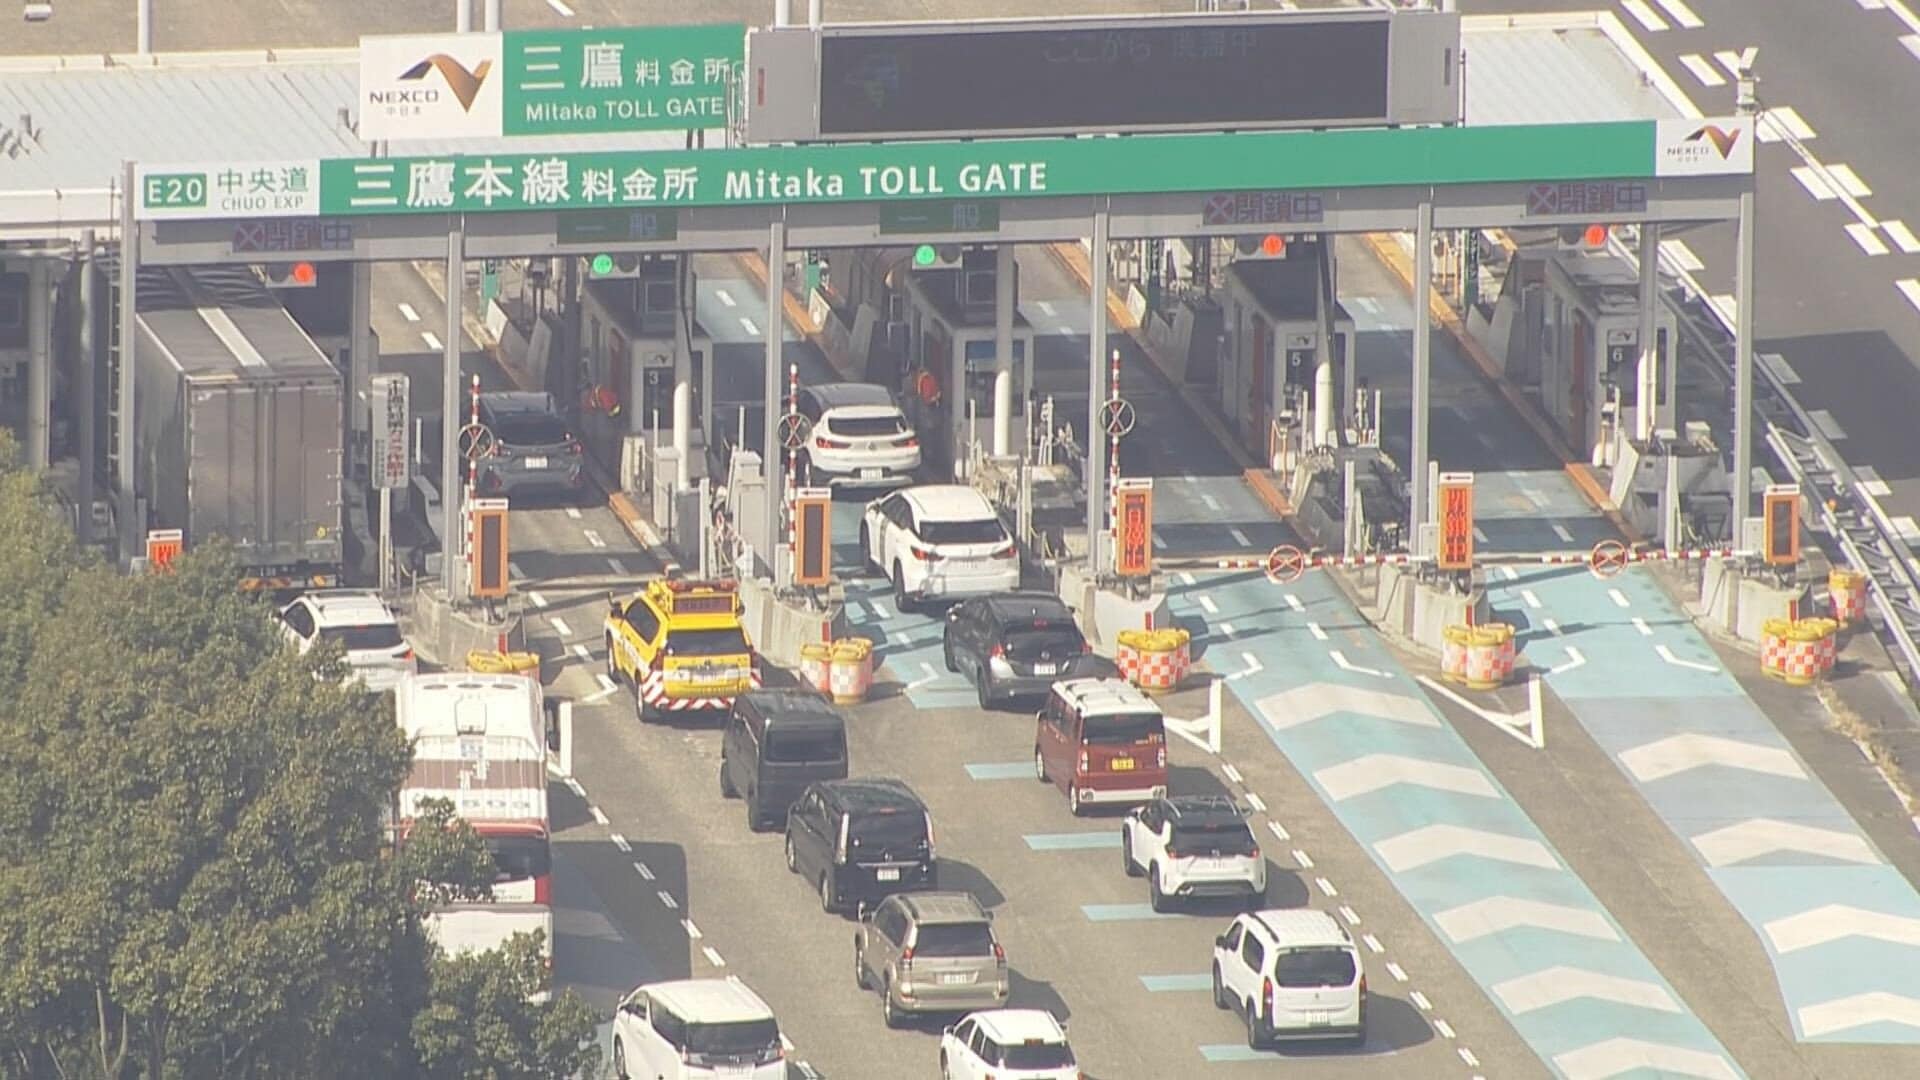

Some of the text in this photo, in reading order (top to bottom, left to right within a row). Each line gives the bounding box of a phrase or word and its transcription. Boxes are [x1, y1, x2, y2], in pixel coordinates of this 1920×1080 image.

[369, 89, 440, 104] NEXCO
[525, 97, 724, 121] Mitaka TOLL GATE
[148, 178, 203, 203] E20
[217, 167, 309, 194] 中央道
[724, 162, 1048, 200] Mitaka TOLL GATE
[221, 195, 304, 210] CHUO EXP
